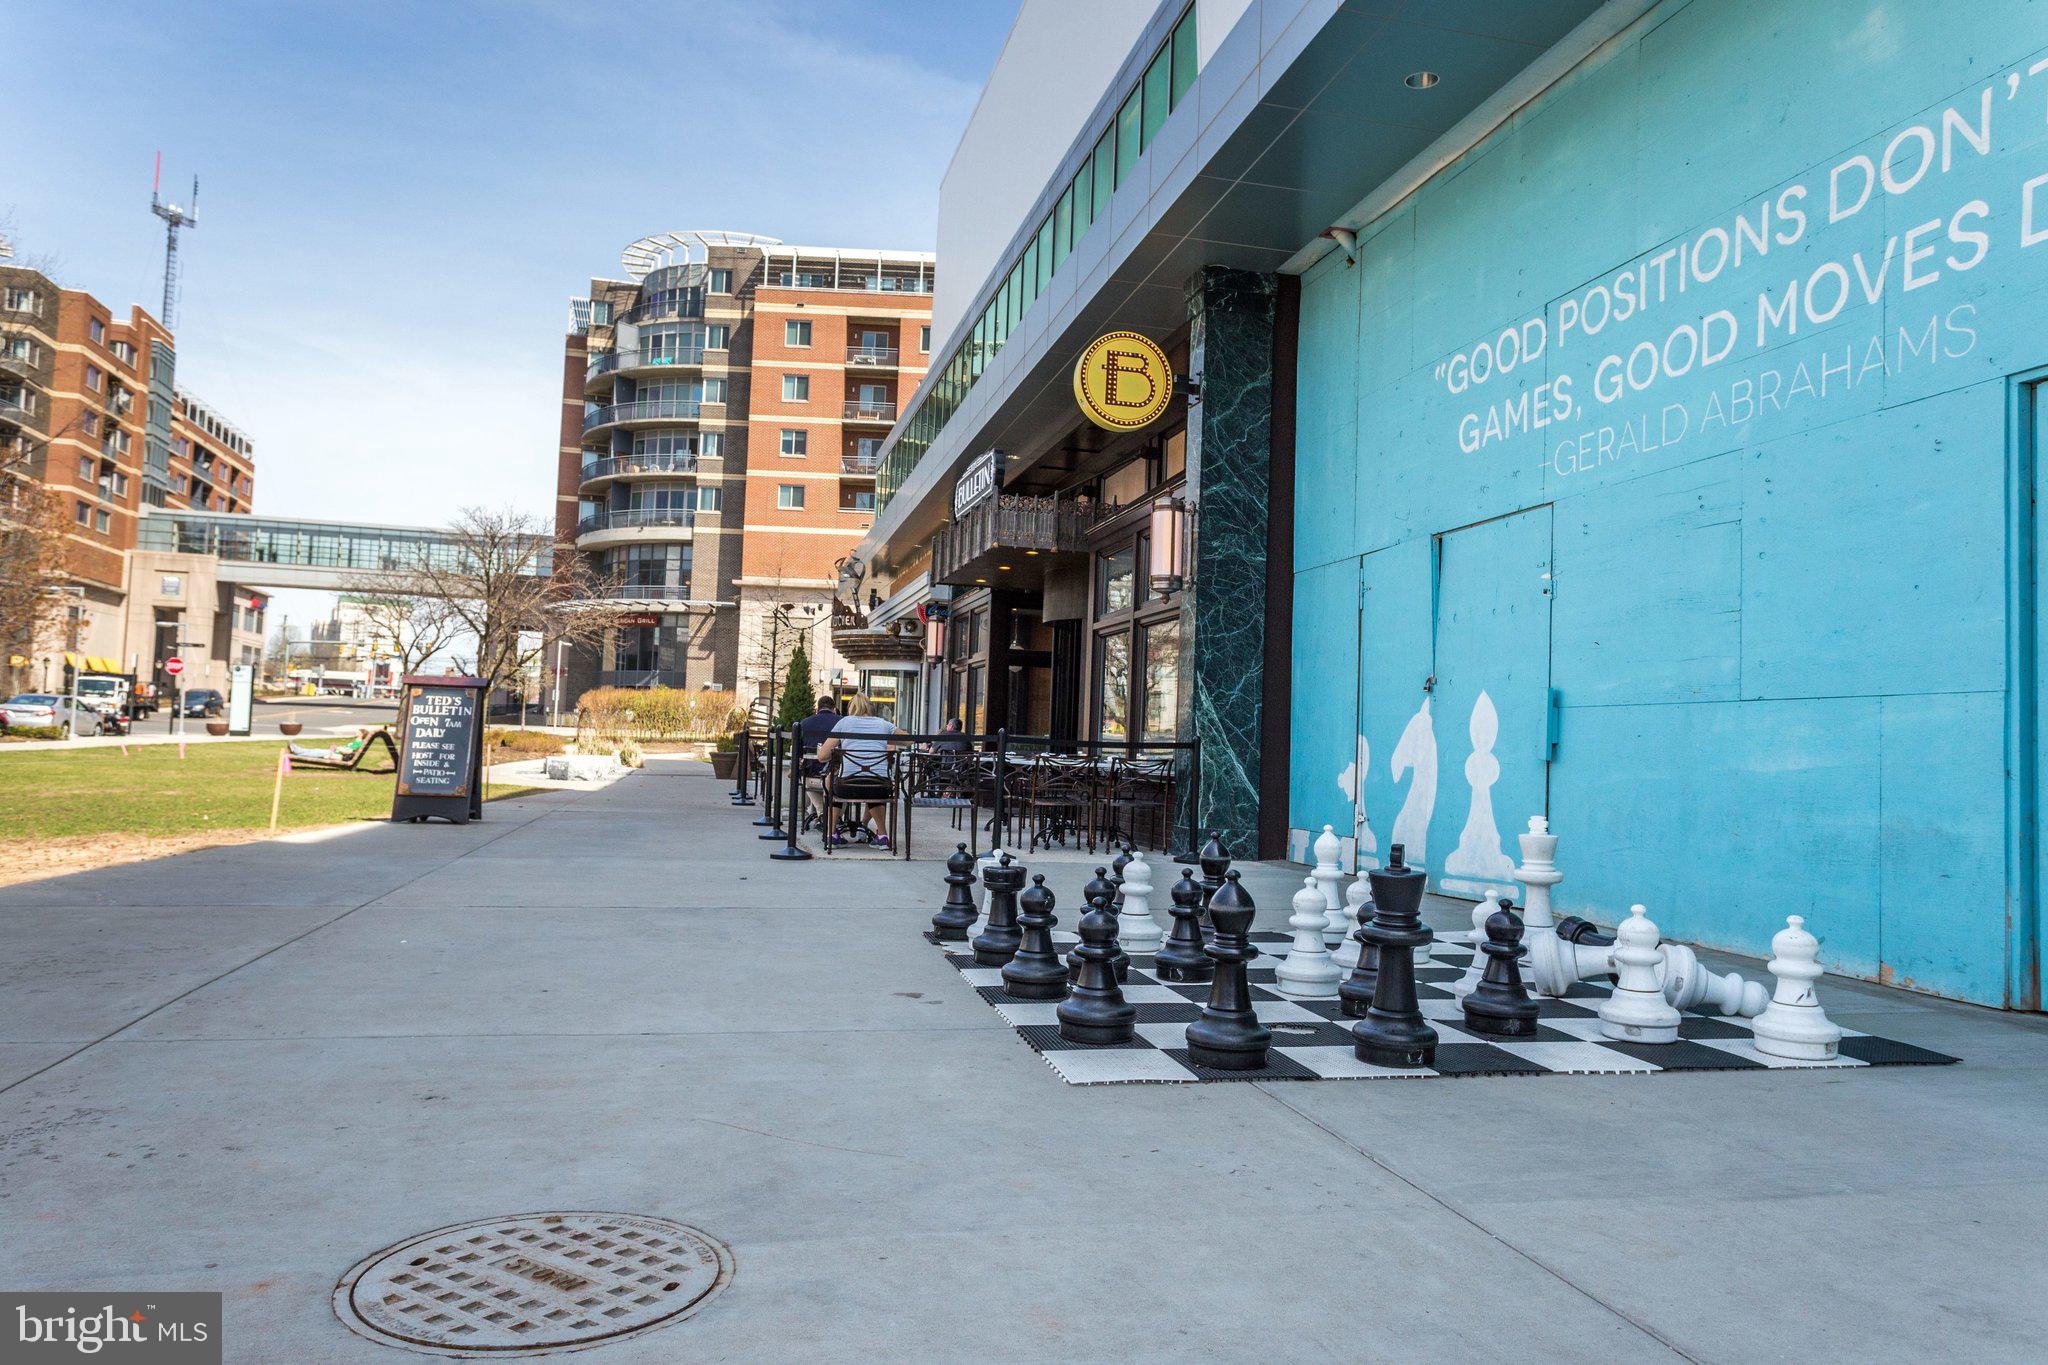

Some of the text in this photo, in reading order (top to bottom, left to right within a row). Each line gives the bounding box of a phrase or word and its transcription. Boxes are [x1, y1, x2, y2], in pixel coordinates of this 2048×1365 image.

[1559, 184, 1808, 347] POSITIONS
[1458, 374, 1581, 453] GAMES,
[1594, 310, 1738, 404] GOOD
[1757, 199, 1990, 347] MOVES
[1700, 304, 1976, 433] ABRAHAMS
[958, 463, 991, 508] BULLETIN
[425, 695, 462, 705] TED'S
[412, 705, 472, 716] BULLETIN
[410, 716, 438, 727] OPEN
[415, 728, 446, 738] DAILY
[411, 742, 455, 751] PLEASE SEE
[411, 752, 455, 761] HOST FOR
[415, 777, 450, 785] SEATING
